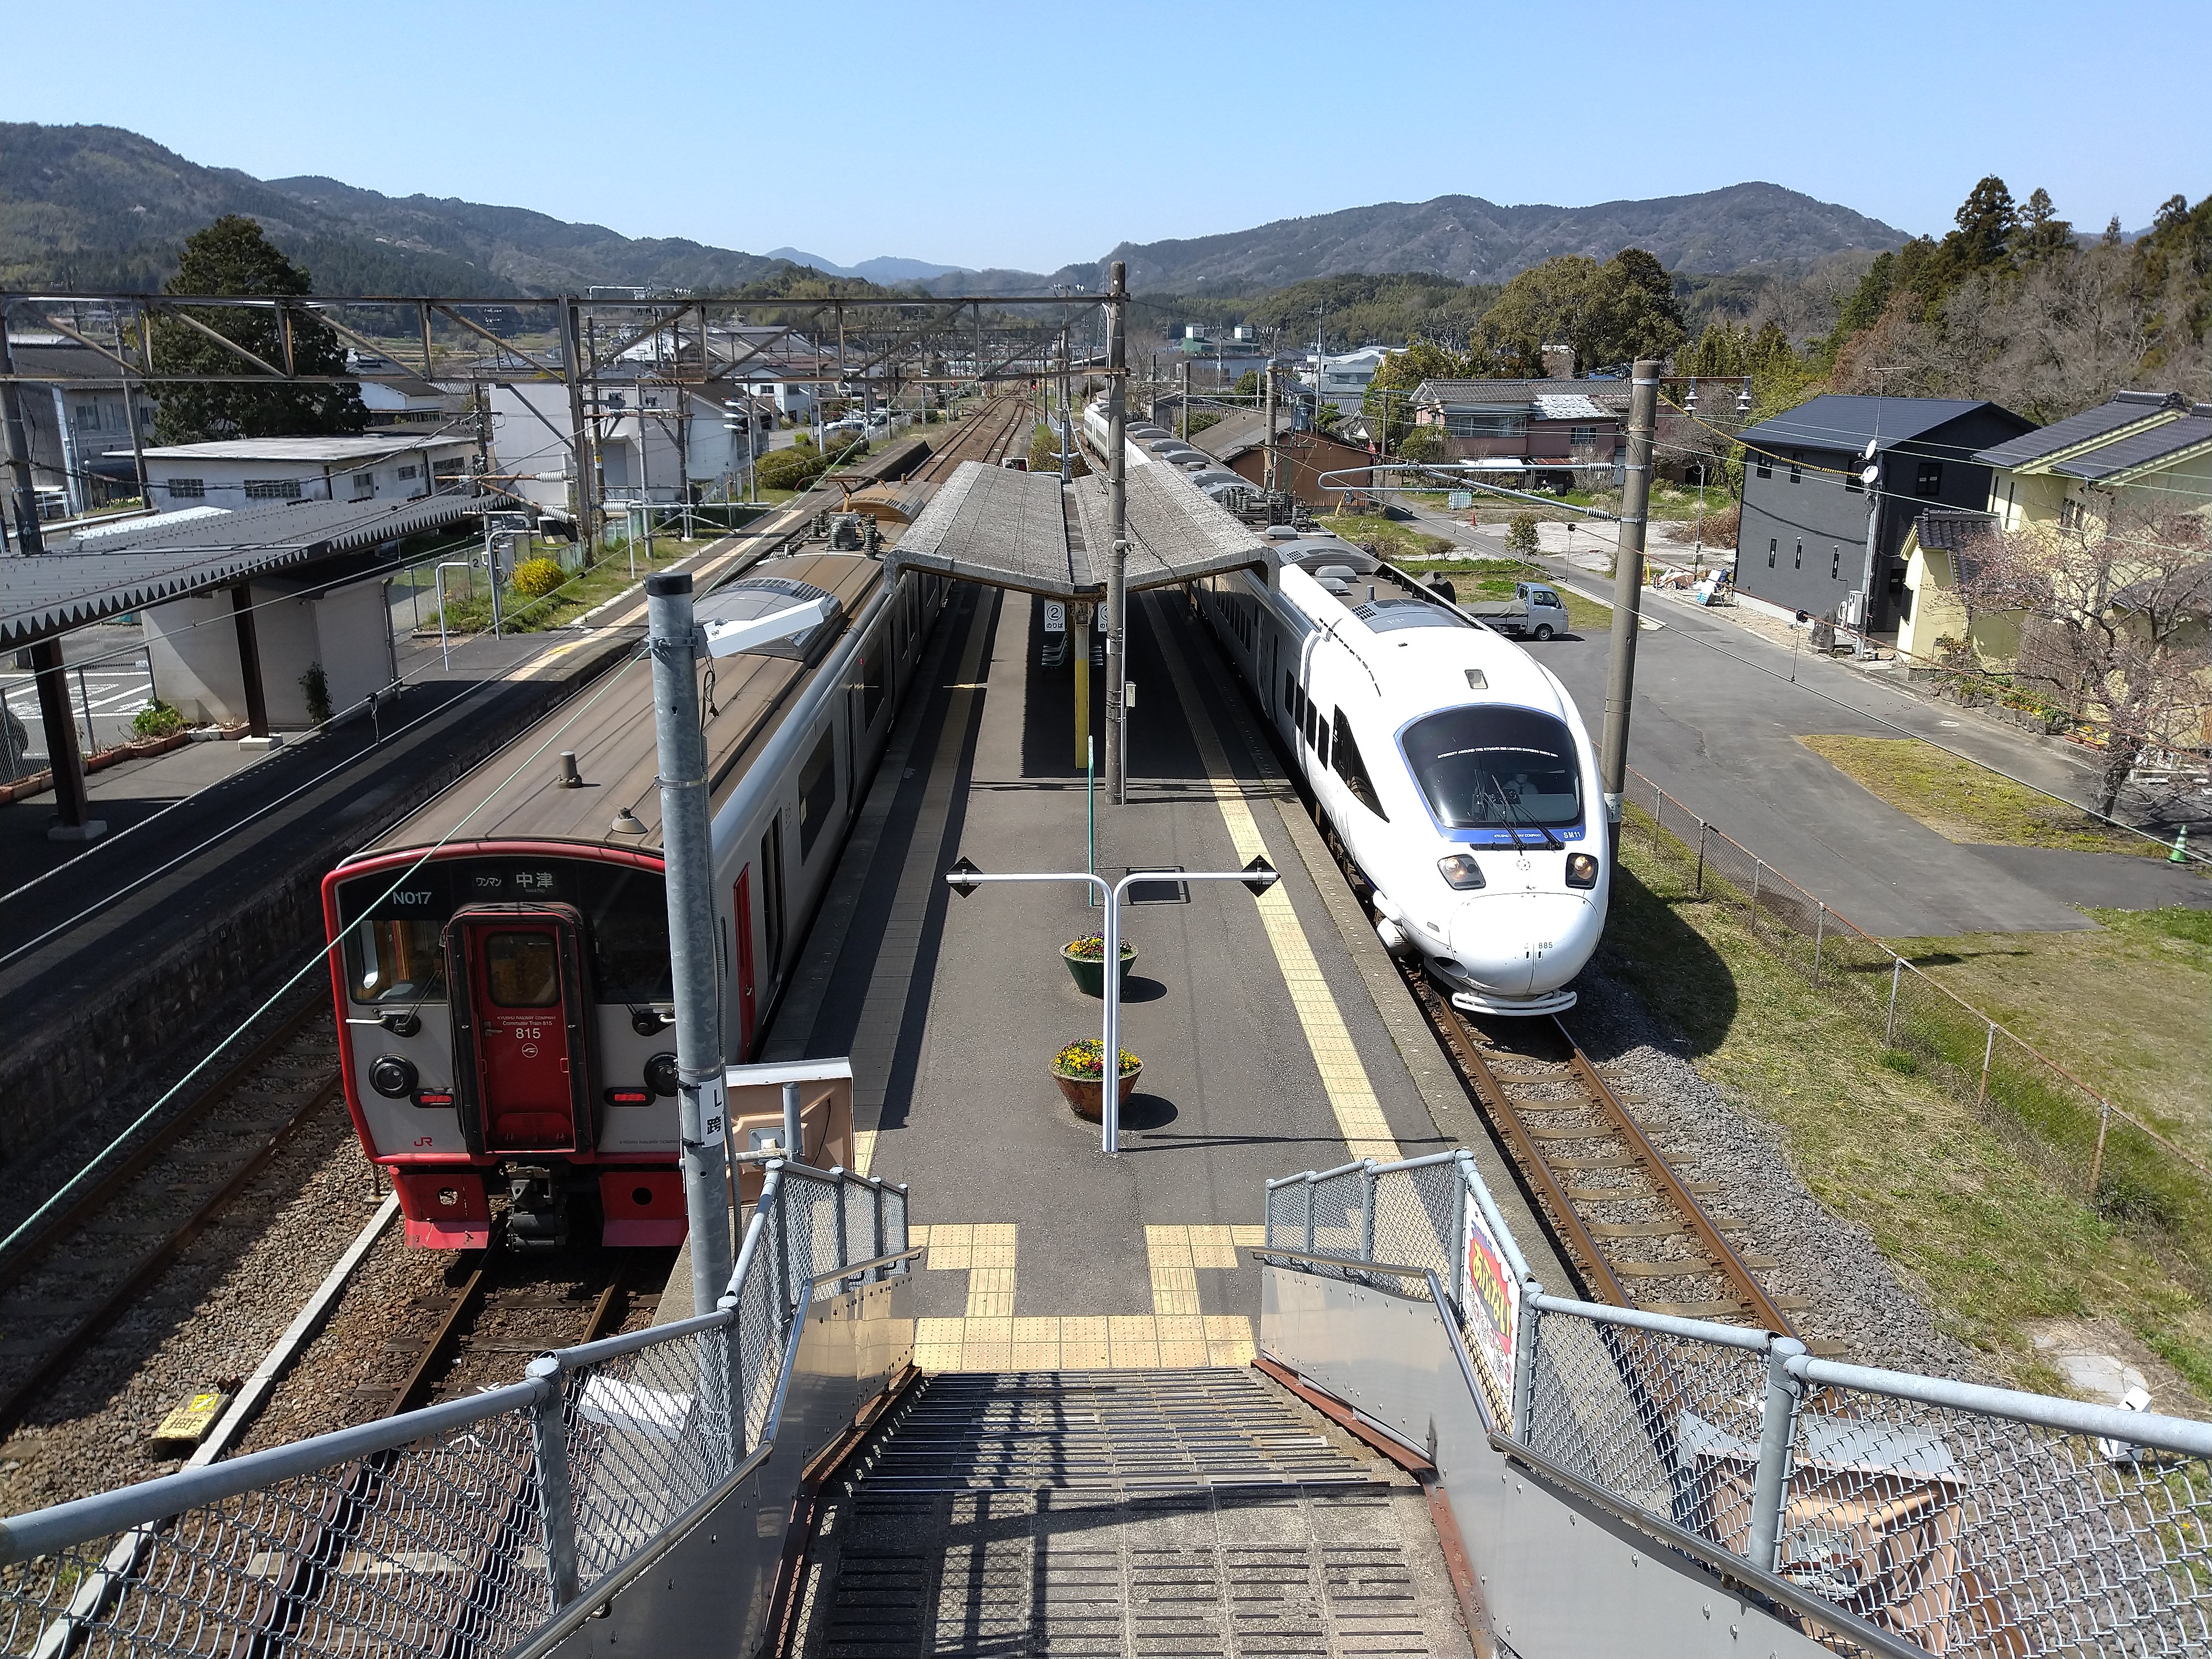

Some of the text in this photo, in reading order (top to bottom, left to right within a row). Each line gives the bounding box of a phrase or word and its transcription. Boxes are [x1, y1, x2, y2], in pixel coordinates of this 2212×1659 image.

[476, 877, 502, 886] ワンマン
[516, 872, 554, 888] 中津
[516, 1028, 541, 1039] 815
[414, 1137, 433, 1147] JR
